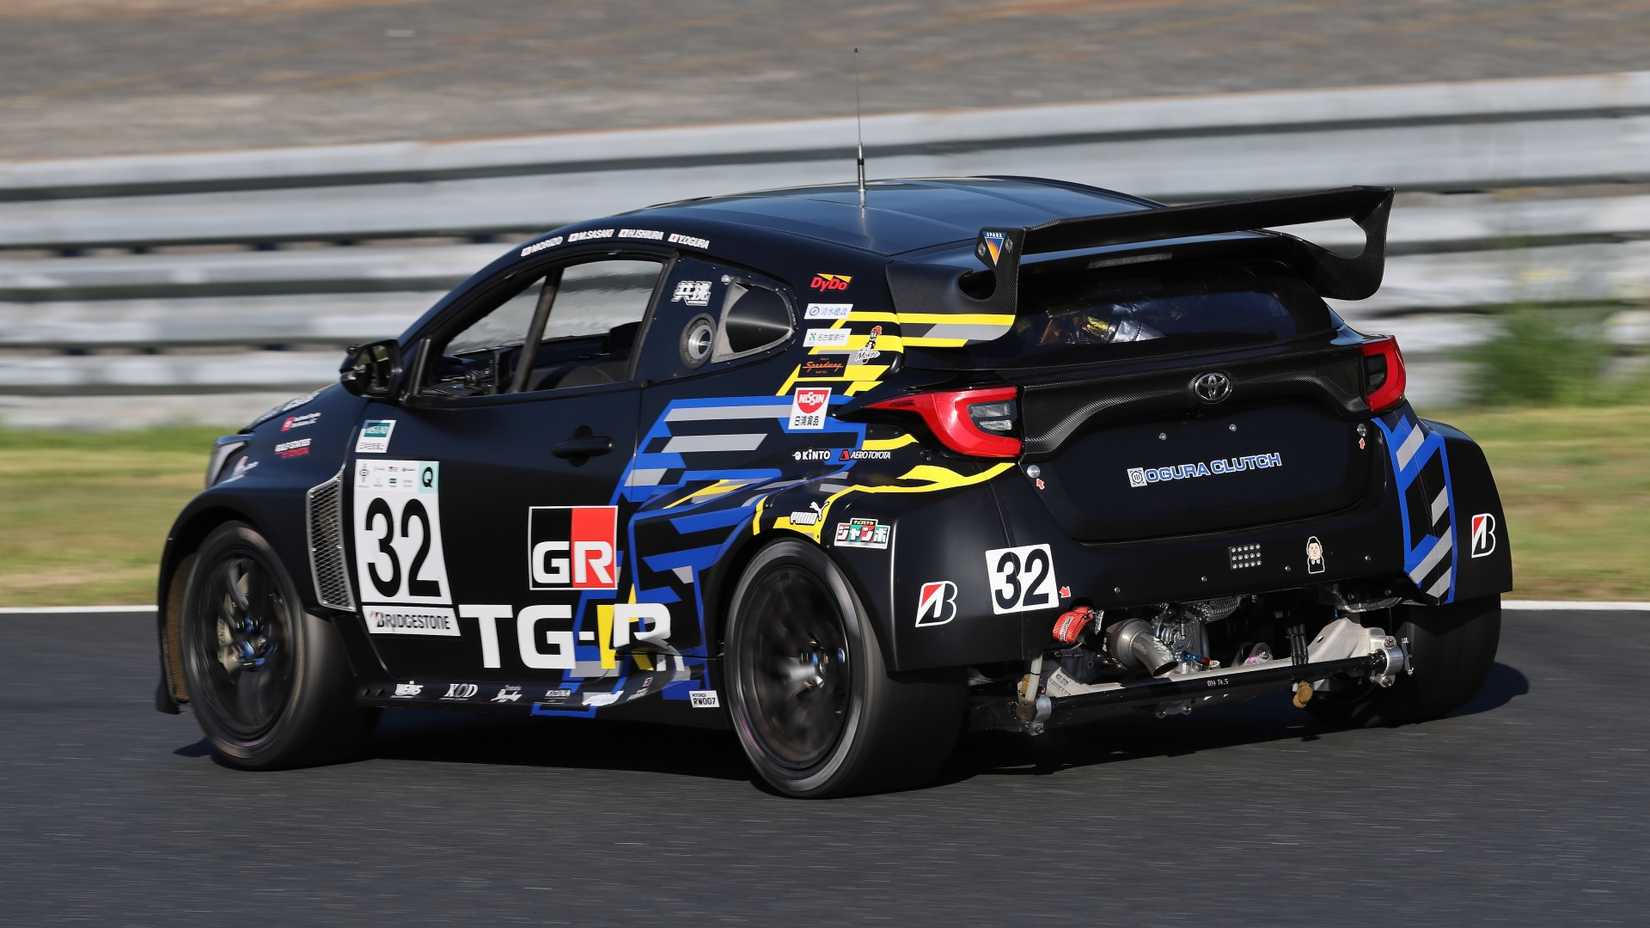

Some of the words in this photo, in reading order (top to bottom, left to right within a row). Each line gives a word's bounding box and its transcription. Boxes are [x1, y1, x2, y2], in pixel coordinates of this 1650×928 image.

[811, 276, 848, 291] DyDo
[799, 392, 825, 406] NISSIN
[794, 415, 819, 426] 日清食品
[421, 466, 433, 489] Q
[1145, 462, 1210, 482] OGURA
[1210, 452, 1282, 474] CLUTCH
[837, 526, 887, 542] ジャンボ
[365, 496, 442, 598] 32
[532, 541, 614, 584] GR
[994, 548, 1050, 610] 32
[371, 611, 451, 630] BRIDGESTONE
